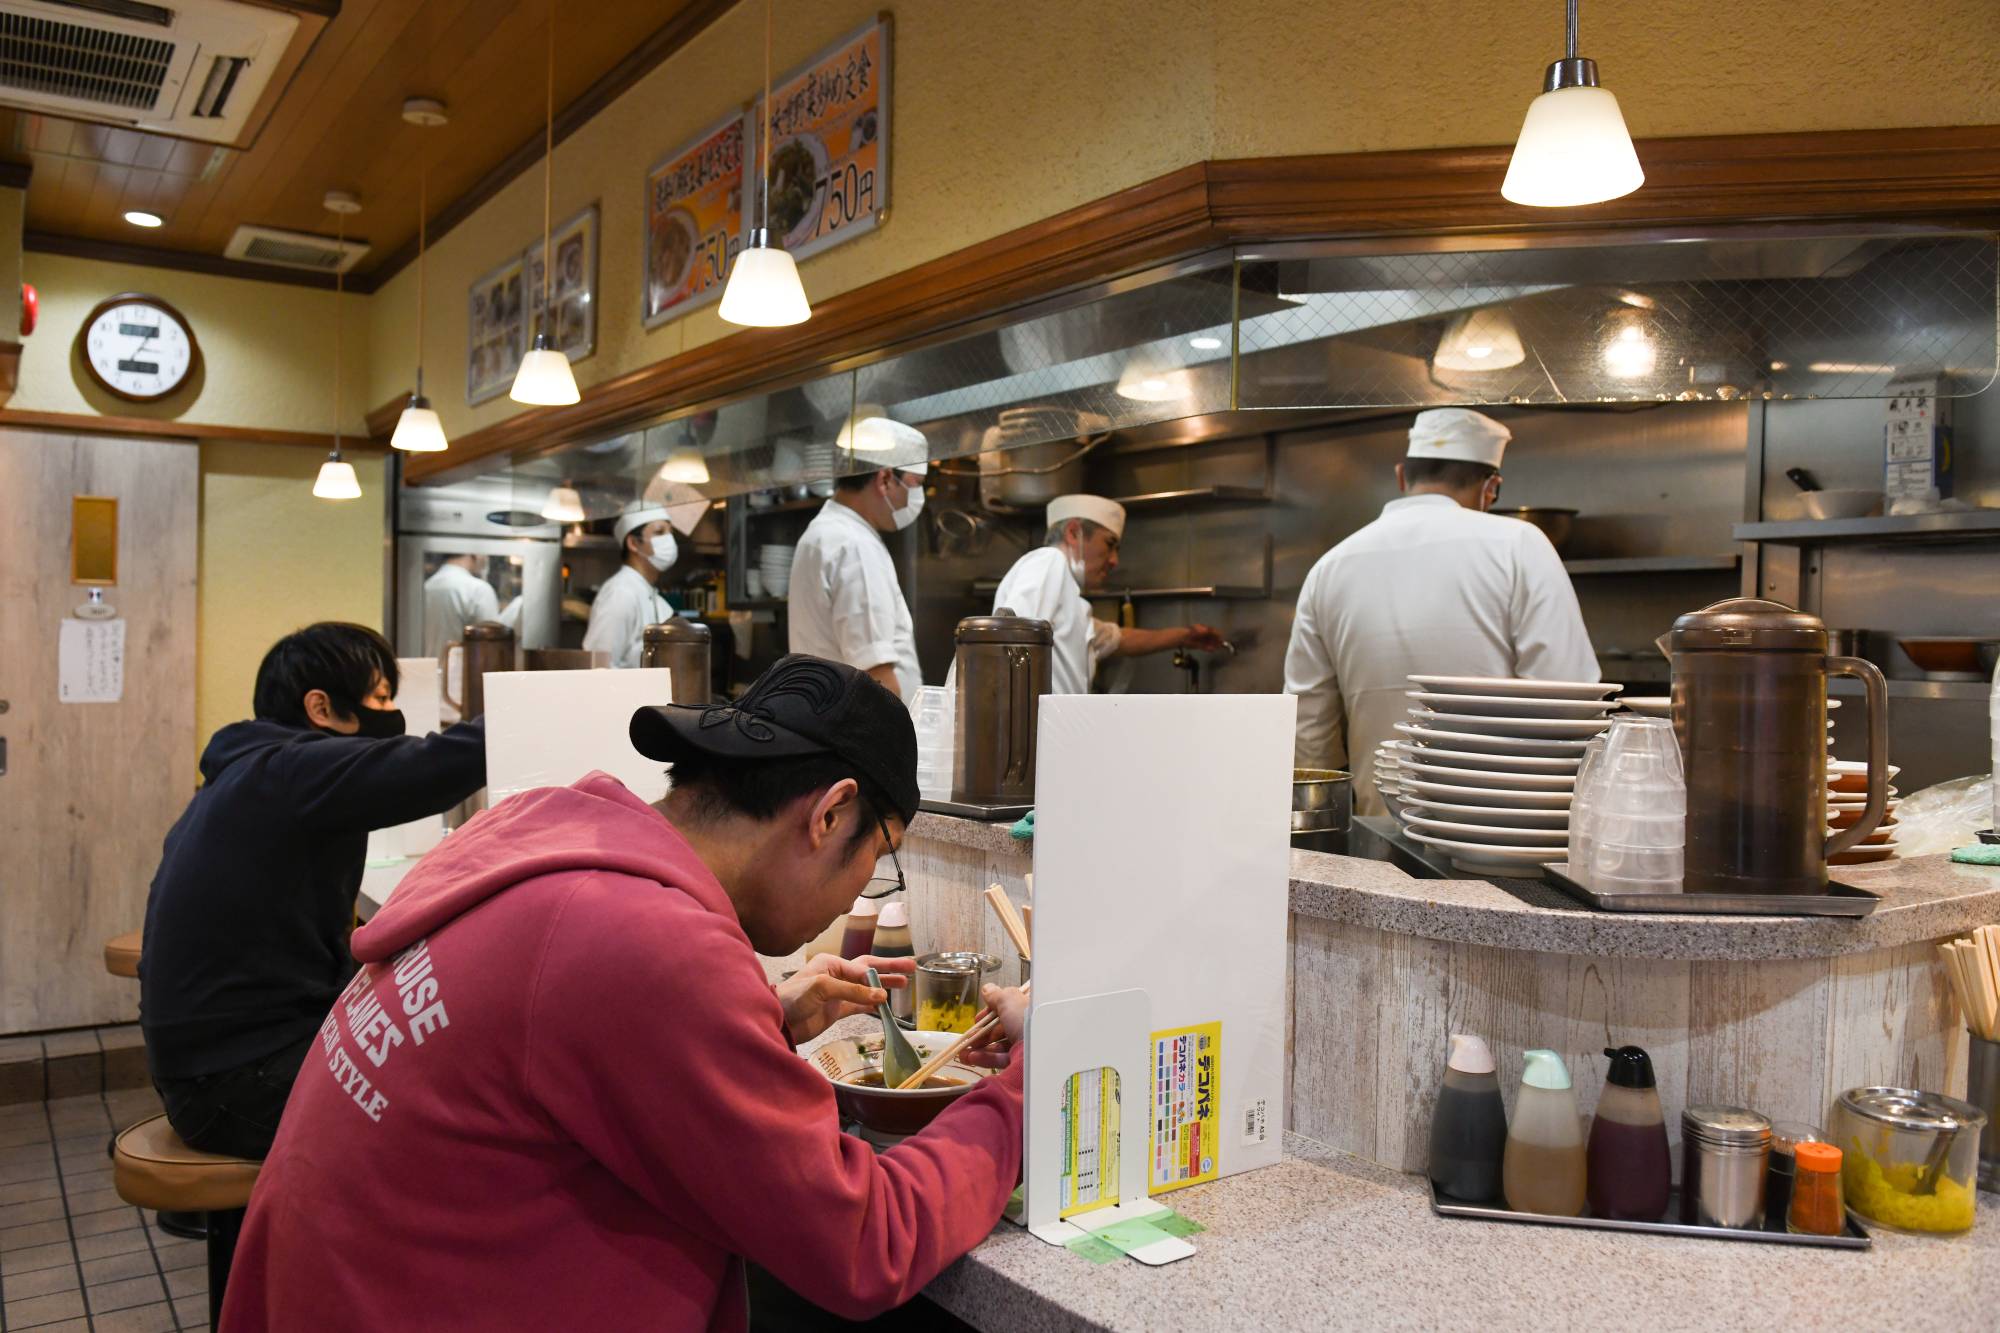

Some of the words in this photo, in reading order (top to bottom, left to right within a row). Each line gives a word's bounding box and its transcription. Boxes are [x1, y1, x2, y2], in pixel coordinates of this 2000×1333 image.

[814, 163, 874, 237] 750円
[327, 1046, 390, 1122] STYLE
[1197, 1055, 1210, 1120] デコパネ
